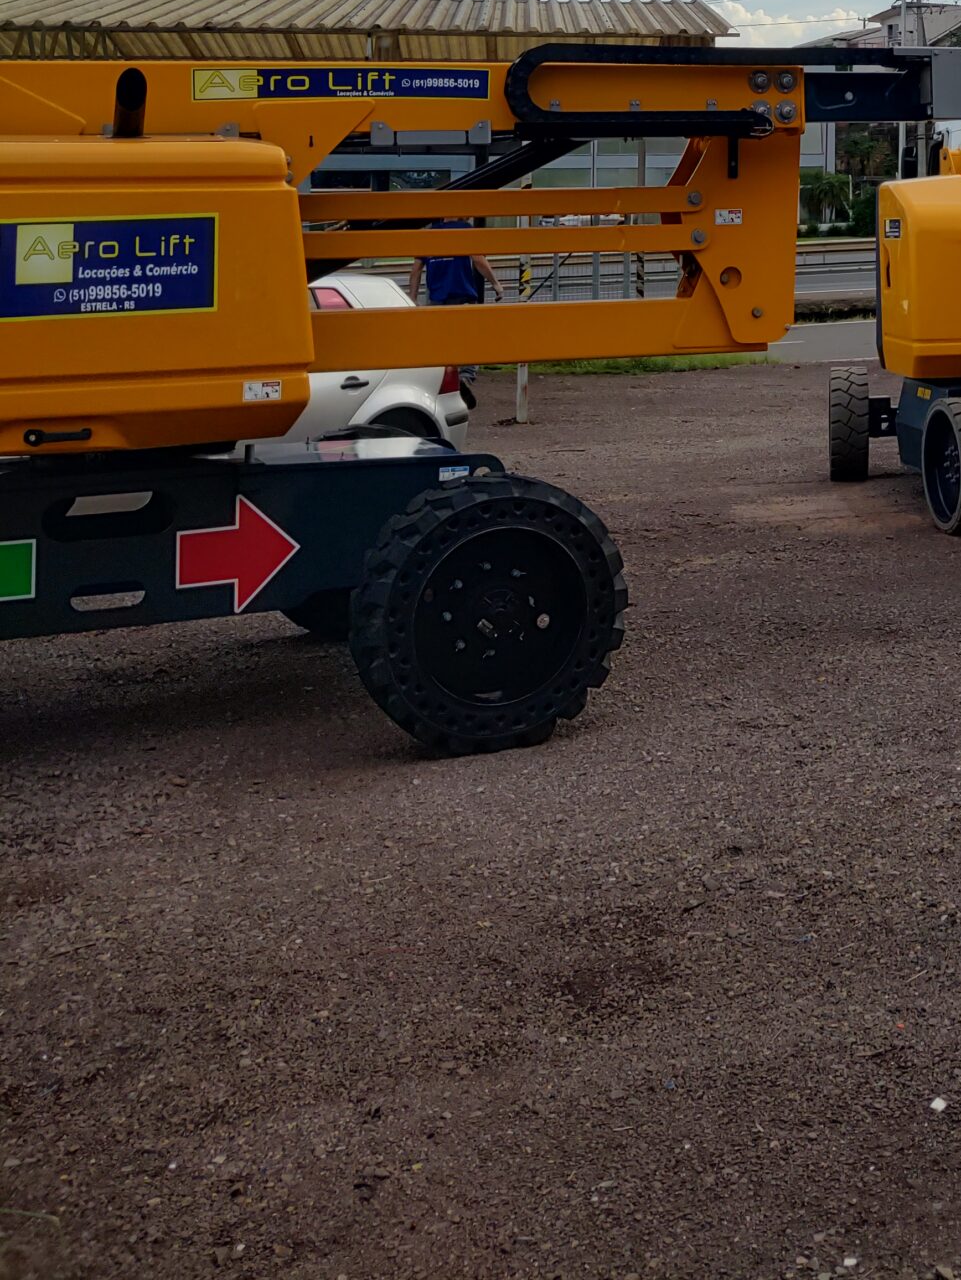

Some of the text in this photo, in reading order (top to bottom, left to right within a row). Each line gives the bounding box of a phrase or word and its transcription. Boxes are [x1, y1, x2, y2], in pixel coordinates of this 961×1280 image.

[199, 70, 480, 93] Aero Lift (51)99856-5019
[23, 233, 196, 262] Aero Lift
[78, 261, 199, 280] Locações & Comércio
[69, 283, 162, 302] (51)99856-5019
[80, 301, 118, 312] ESTRELA
[123, 300, 136, 310] RS
